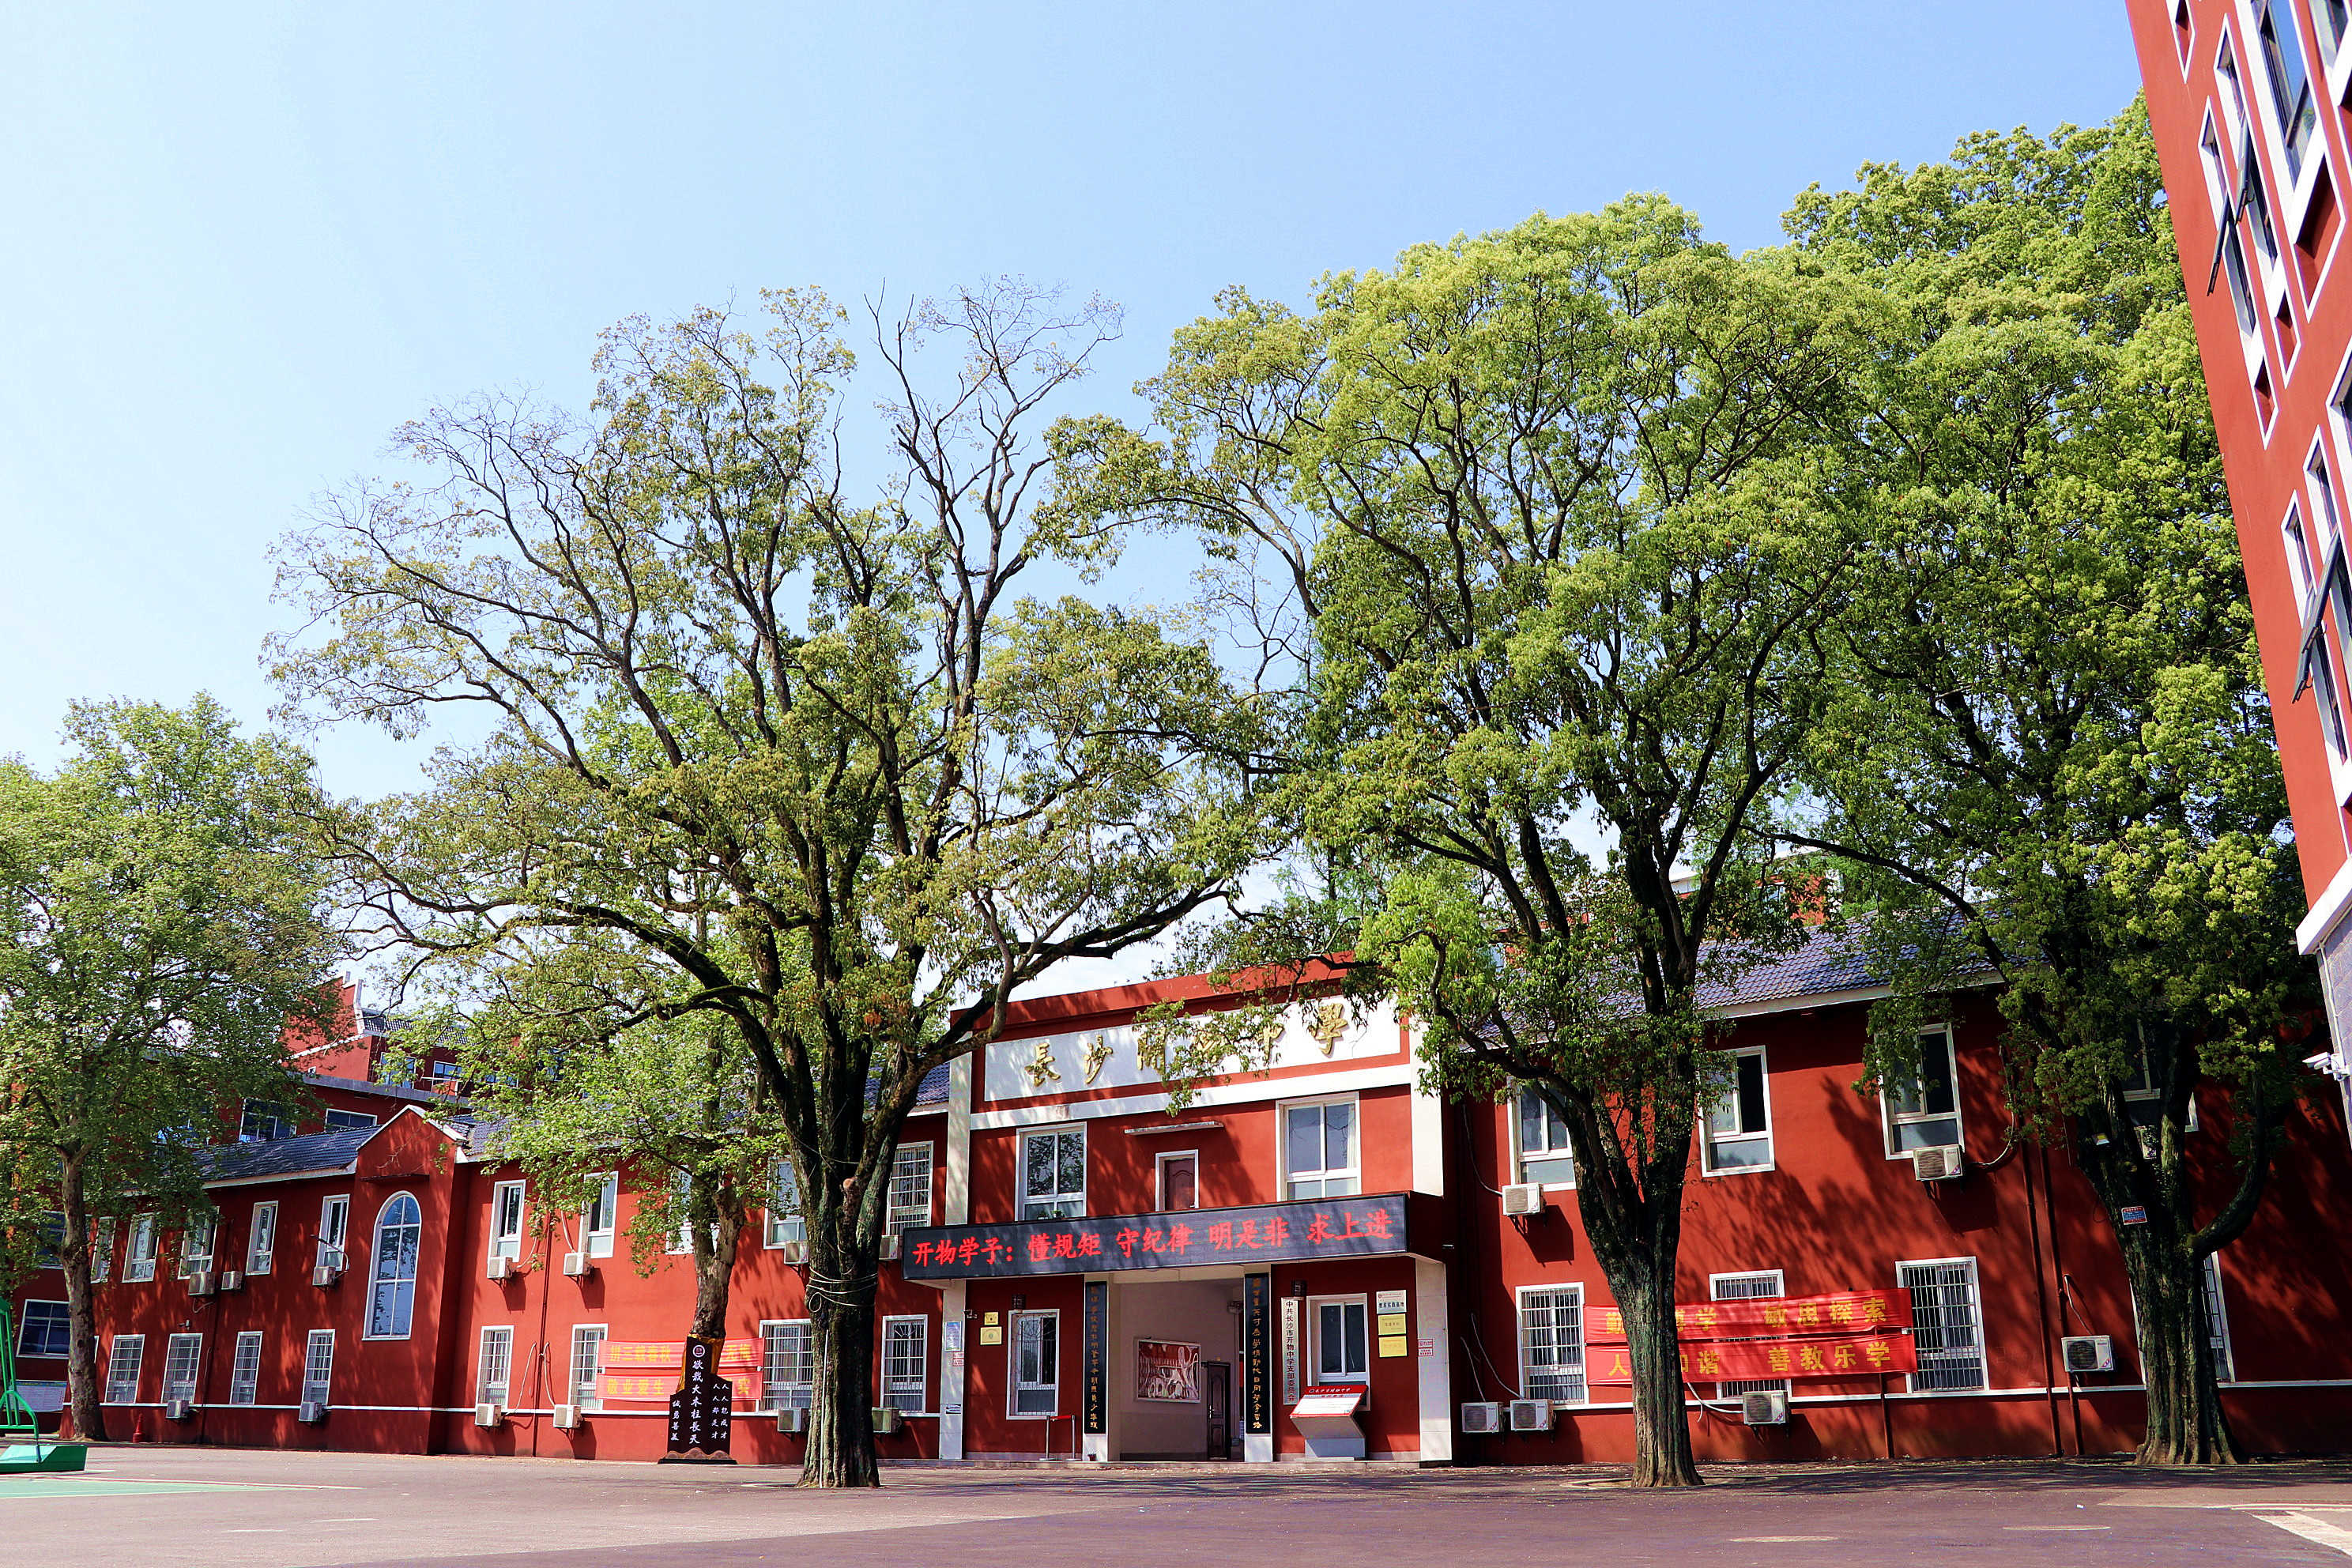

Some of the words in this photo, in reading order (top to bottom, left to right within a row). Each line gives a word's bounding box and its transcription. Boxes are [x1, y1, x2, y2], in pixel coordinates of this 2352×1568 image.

[1027, 1232, 1102, 1262] 懂规矩
[1115, 1223, 1194, 1258] 守纪律
[1208, 1216, 1290, 1250] 明是非
[1306, 1208, 1394, 1245] 求上进
[1765, 1297, 1886, 1328] 敏思探索
[1768, 1341, 1890, 1372] 善教乐学
